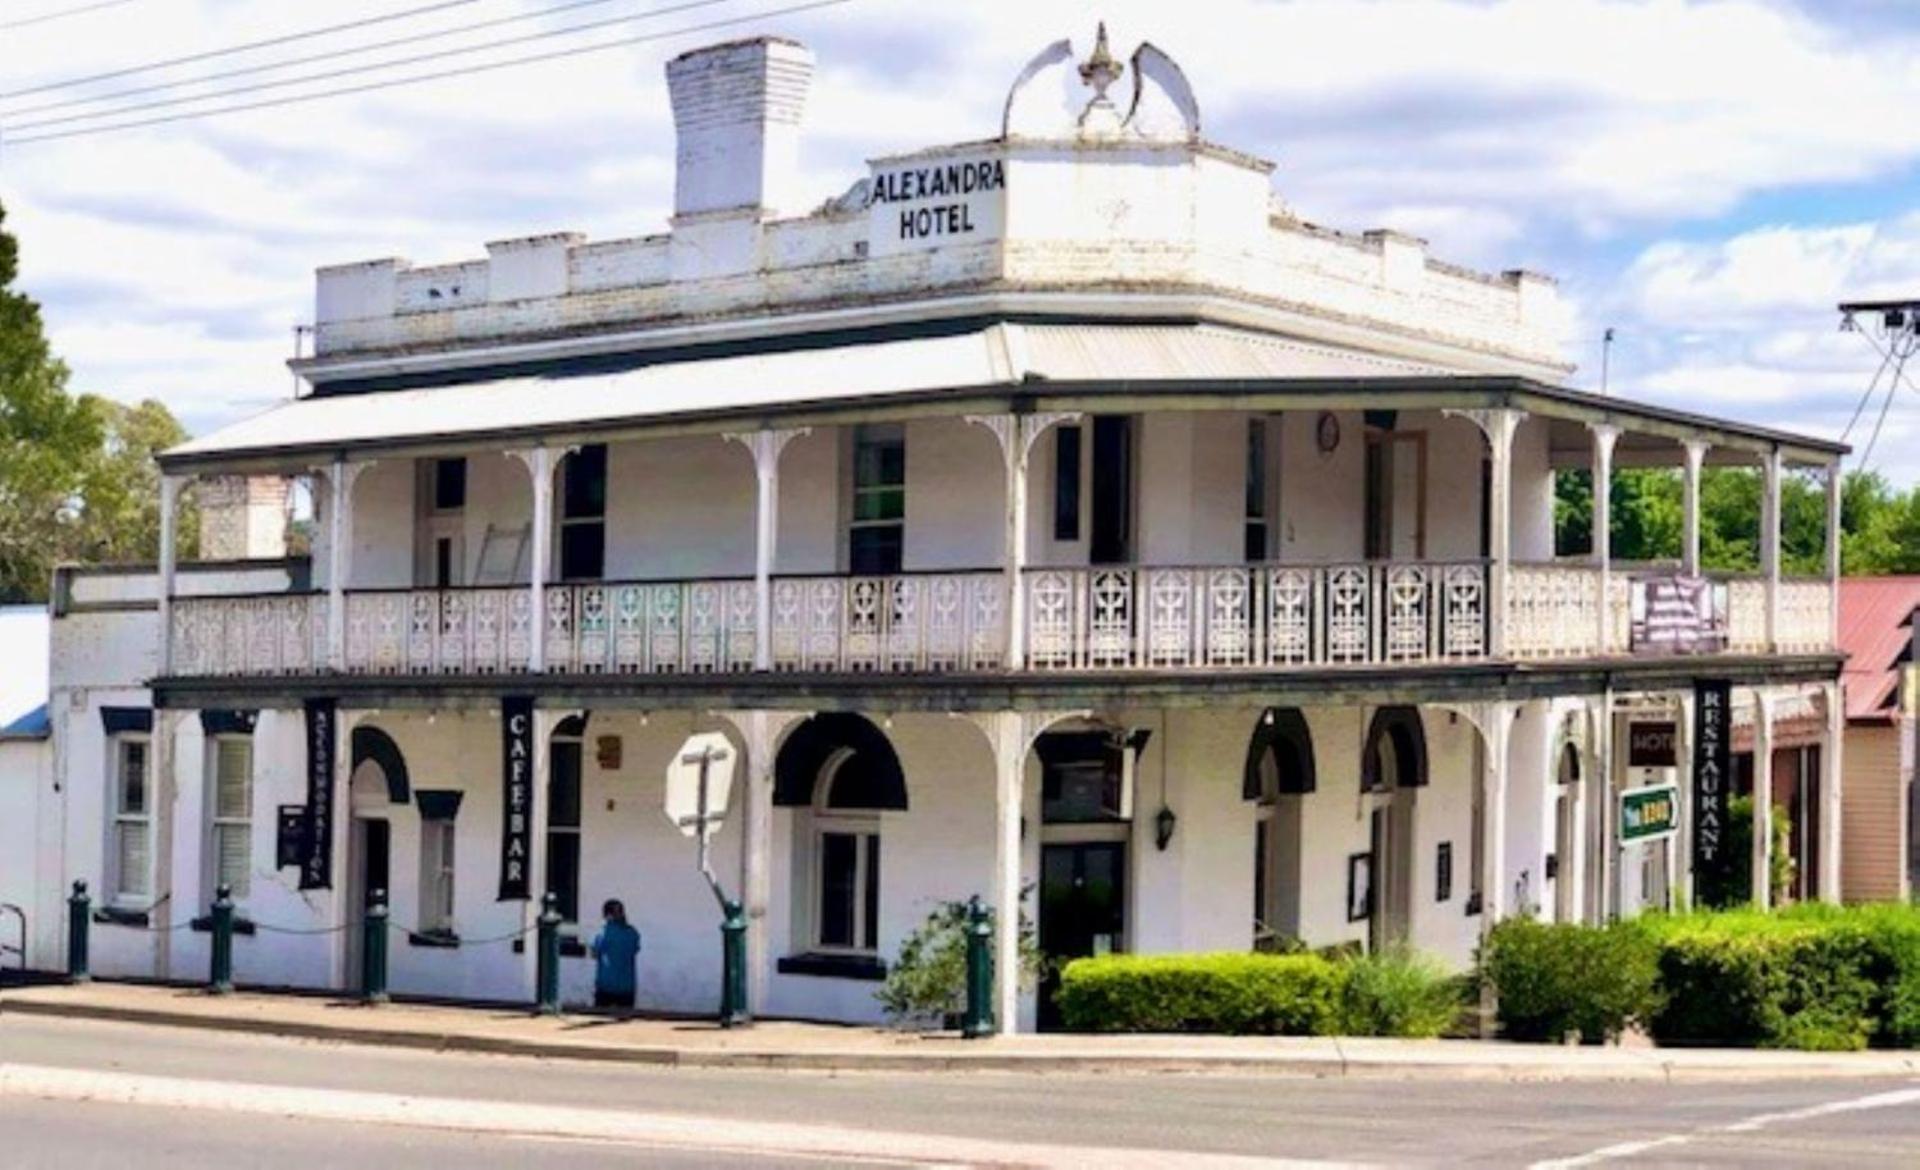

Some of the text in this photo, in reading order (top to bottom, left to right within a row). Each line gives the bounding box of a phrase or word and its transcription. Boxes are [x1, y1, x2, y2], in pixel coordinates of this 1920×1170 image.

[871, 160, 1006, 204] ALEXANDRA
[900, 203, 974, 239] HOTEL
[1700, 690, 1720, 861] RESTAURANT
